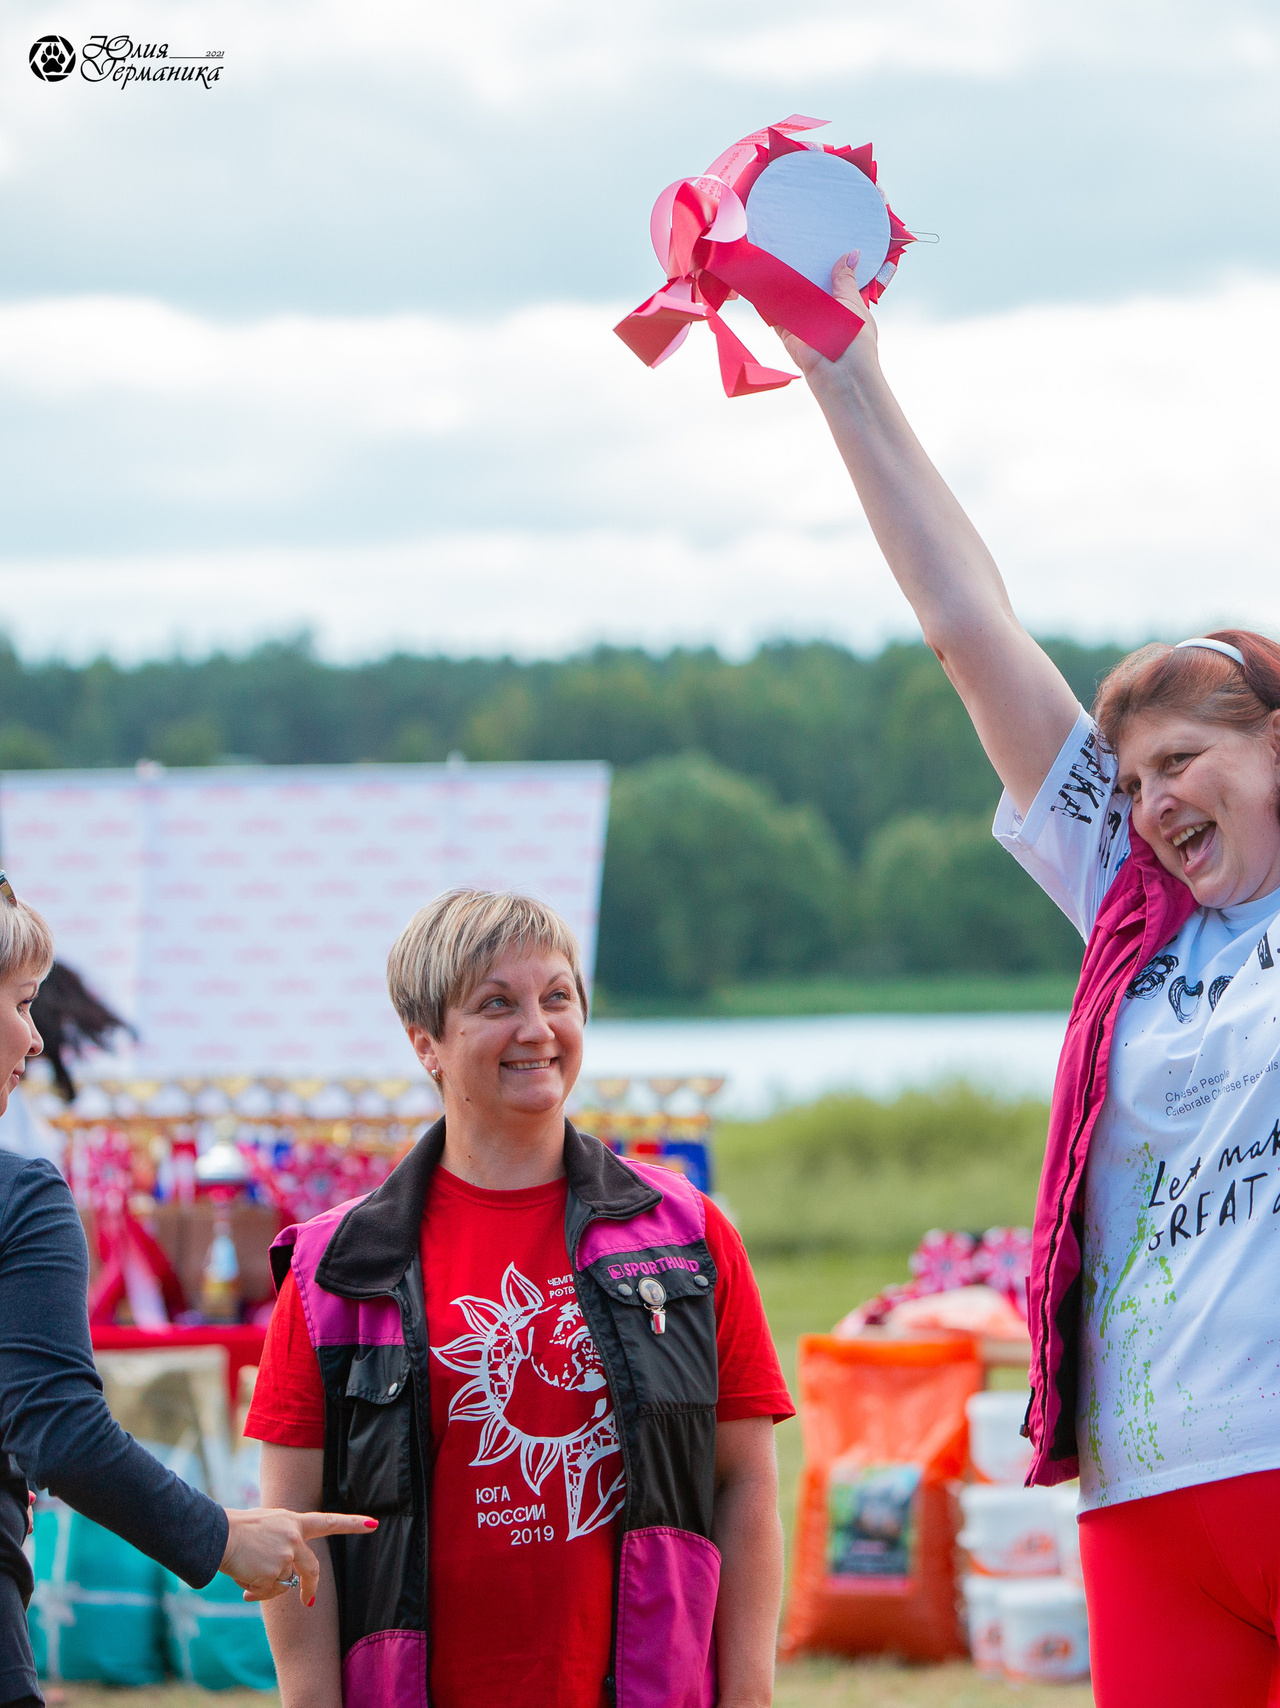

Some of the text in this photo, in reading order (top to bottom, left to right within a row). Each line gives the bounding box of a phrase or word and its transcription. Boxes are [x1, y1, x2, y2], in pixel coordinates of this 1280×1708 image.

[1199, 1069, 1231, 1089] People
[1148, 1156, 1201, 1208] Let
[547, 1273, 574, 1287] ЧЕМП
[476, 1485, 511, 1504] ЮГА
[477, 1503, 546, 1528] РОССИИ
[510, 1525, 555, 1546] 2019
